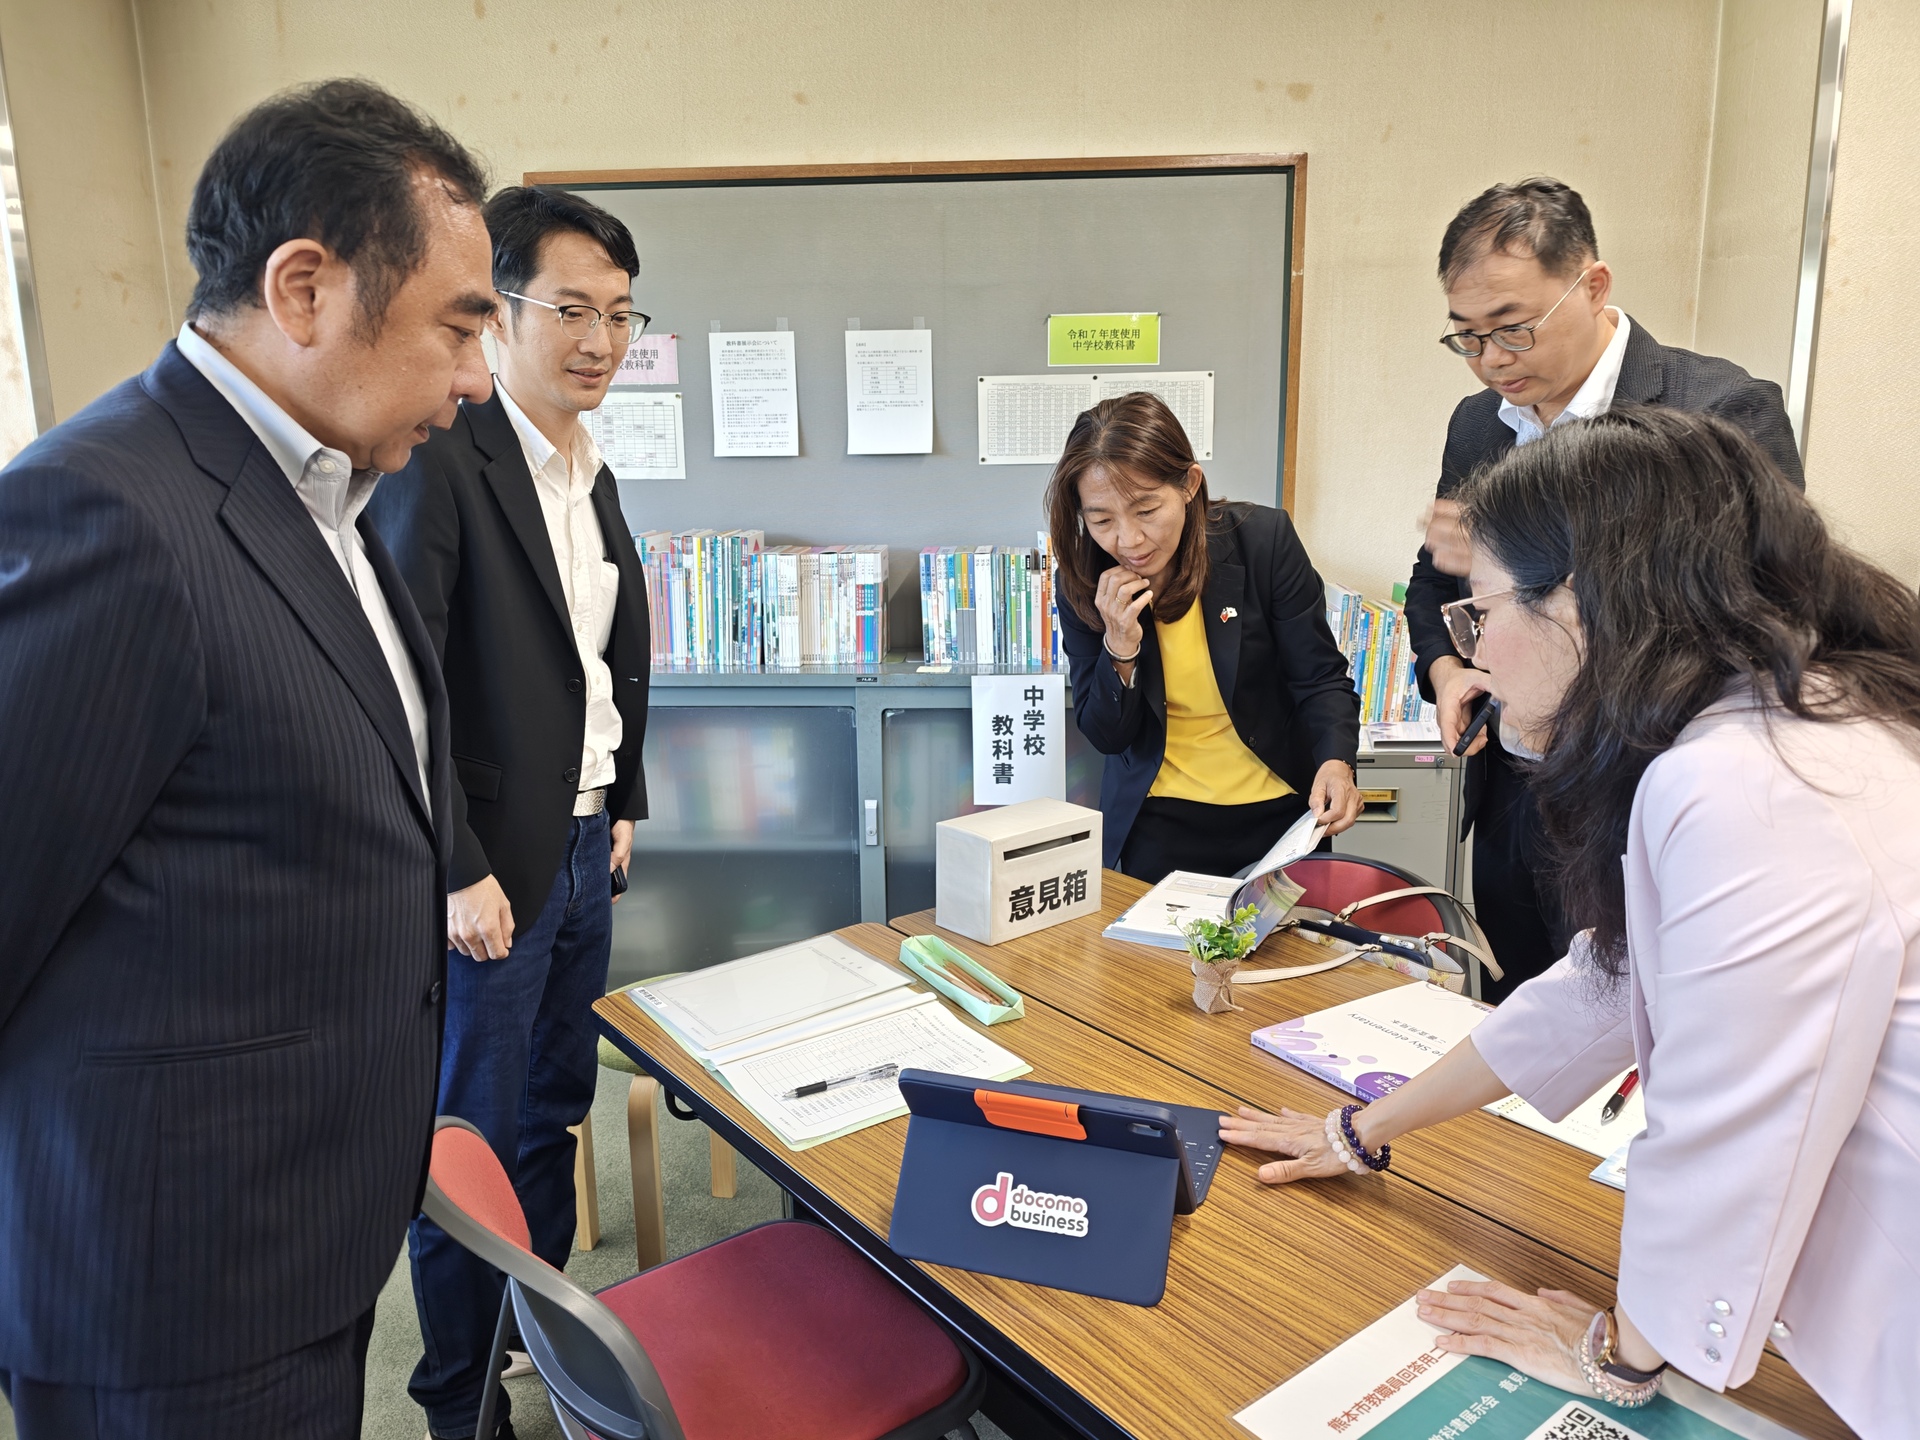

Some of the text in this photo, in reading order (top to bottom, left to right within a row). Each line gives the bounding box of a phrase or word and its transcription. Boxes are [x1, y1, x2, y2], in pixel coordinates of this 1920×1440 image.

[1067, 328, 1141, 340] 令和7年度使用
[1072, 340, 1136, 352] 中学校教科書
[626, 349, 659, 360] 度使用
[1023, 685, 1046, 756] 中学校
[991, 714, 1014, 785] 教科書
[1008, 868, 1088, 923] 意見箱
[1347, 1012, 1409, 1042] elementary
[1408, 1038, 1432, 1052] Sky
[1012, 1188, 1084, 1214] docomo
[1010, 1205, 1085, 1233] business
